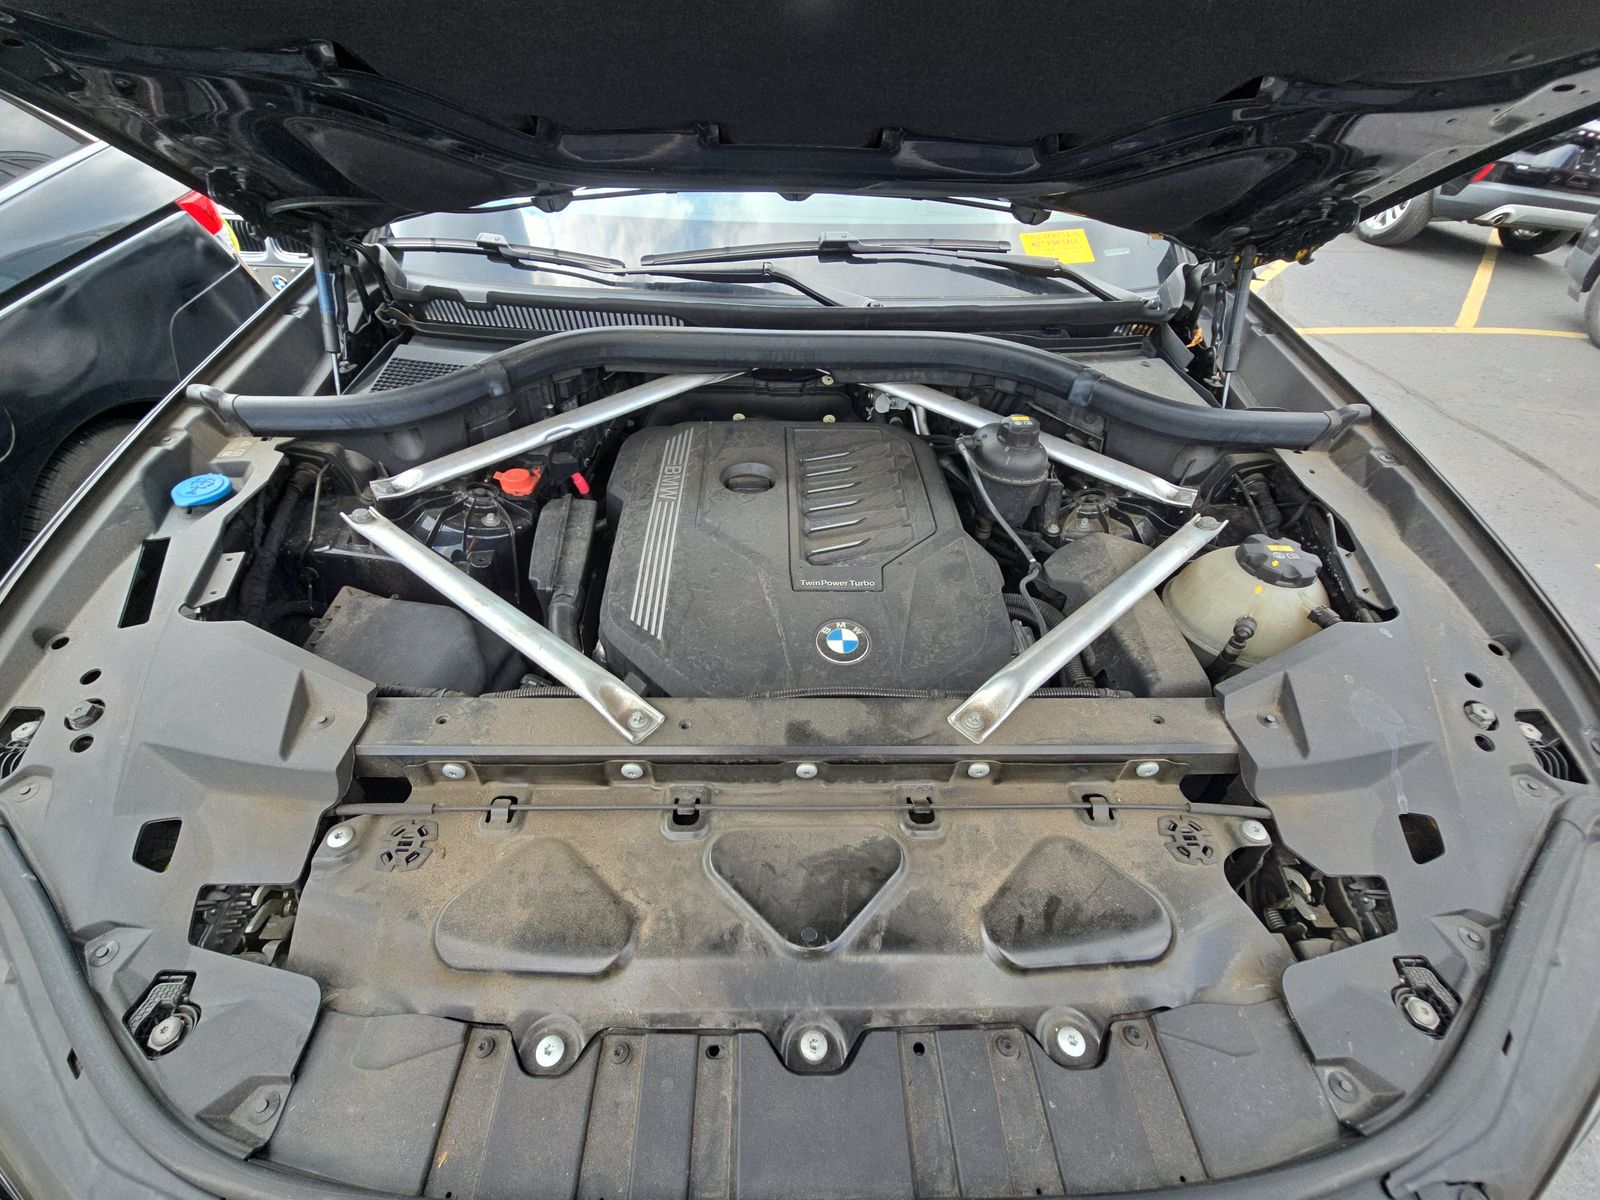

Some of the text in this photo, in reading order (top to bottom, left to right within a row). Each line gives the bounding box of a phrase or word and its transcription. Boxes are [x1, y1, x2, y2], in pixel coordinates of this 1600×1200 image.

[659, 466, 682, 500] BMW
[850, 579, 875, 587] Turbo
[821, 622, 863, 635] BMW
